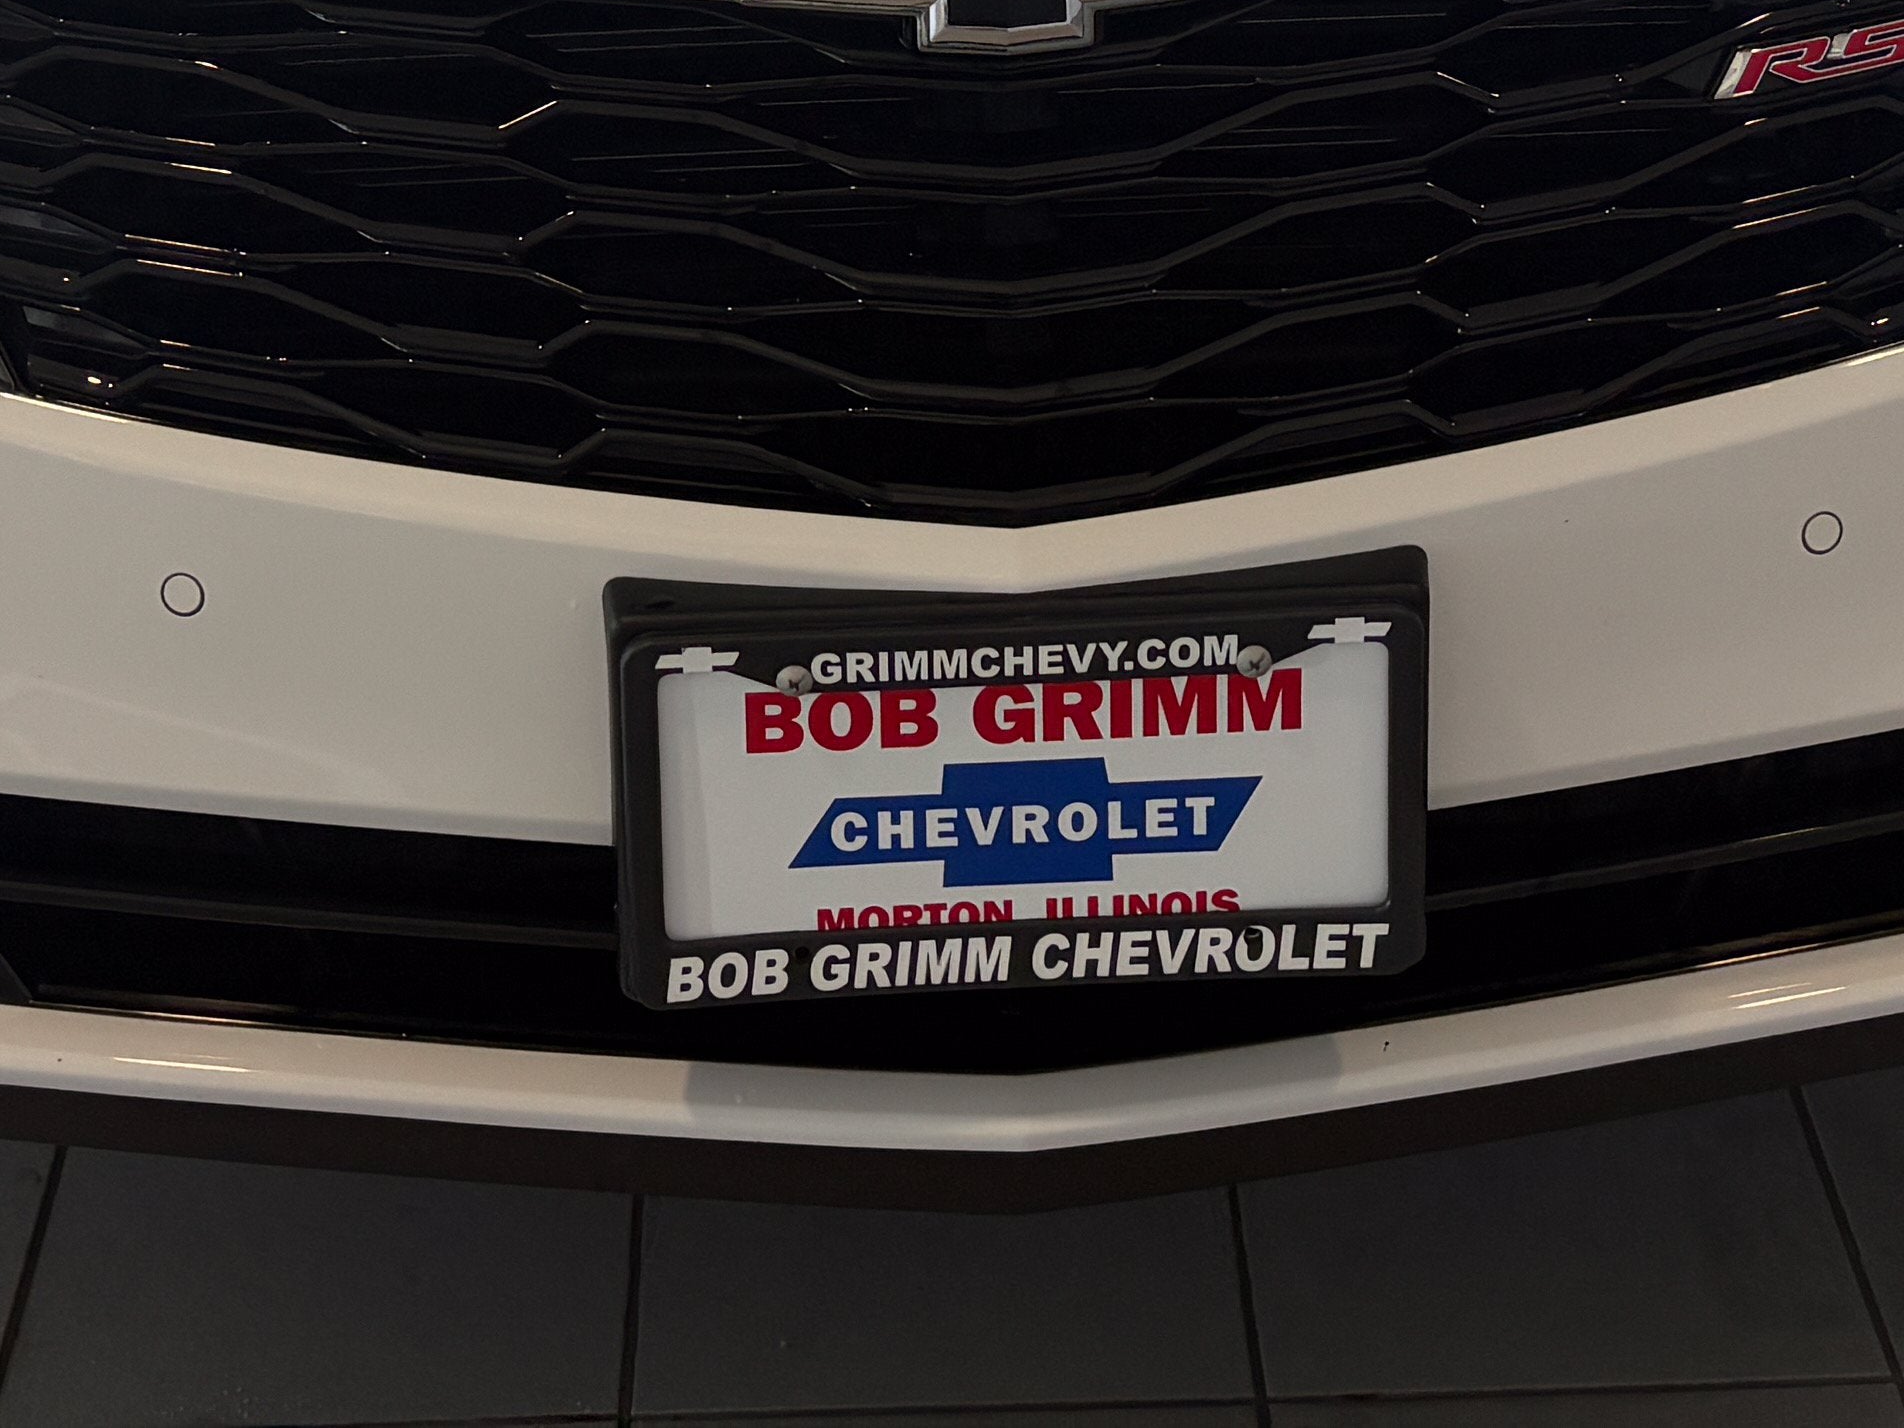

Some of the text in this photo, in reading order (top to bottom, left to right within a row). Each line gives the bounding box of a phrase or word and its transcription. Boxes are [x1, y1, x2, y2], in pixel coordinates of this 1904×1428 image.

[810, 634, 1239, 685] GRIMMCHEVY.COM
[744, 667, 1303, 755] BOB GRIMM
[829, 796, 1216, 852] CHEVROLET
[666, 923, 1390, 1004] BOB GRIMM CHEVROLET
